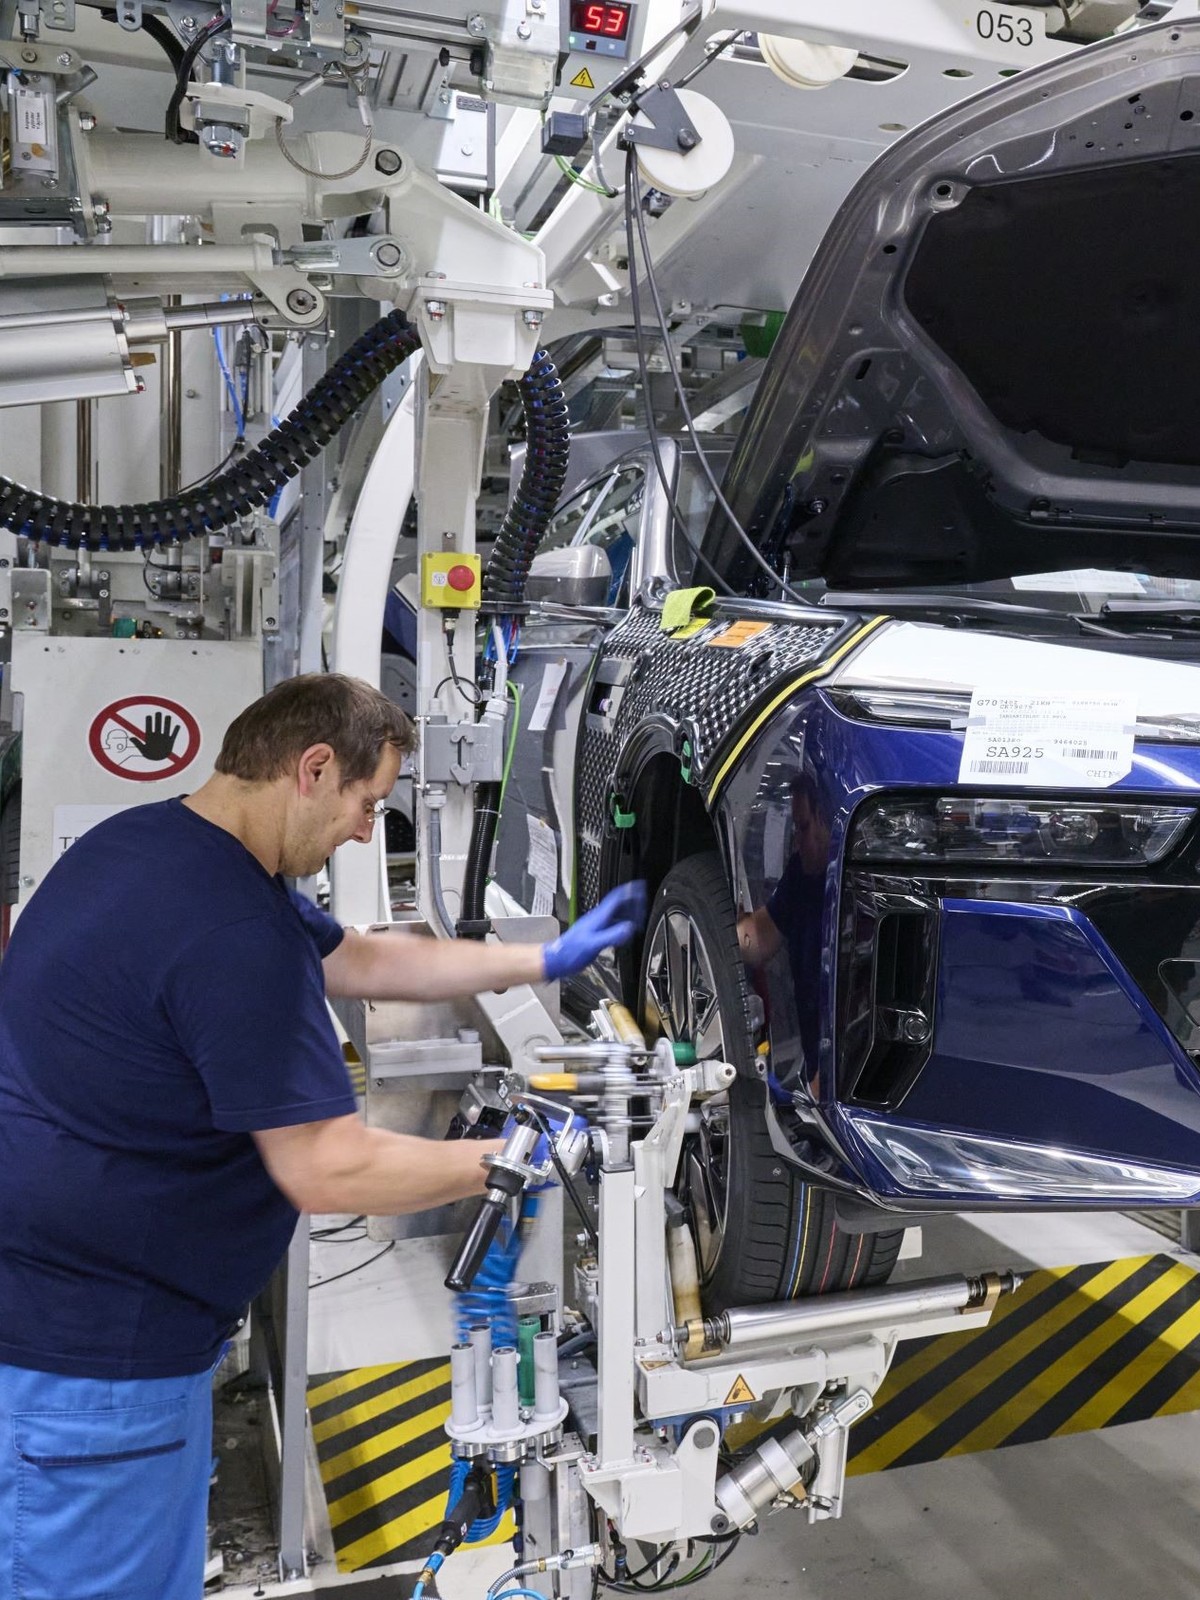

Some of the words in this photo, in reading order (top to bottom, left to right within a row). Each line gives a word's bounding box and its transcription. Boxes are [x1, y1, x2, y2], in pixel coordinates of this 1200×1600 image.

[585, 6, 624, 32] 53
[976, 9, 1034, 47] 053
[976, 699, 998, 707] G70
[985, 745, 1045, 759] SA925
